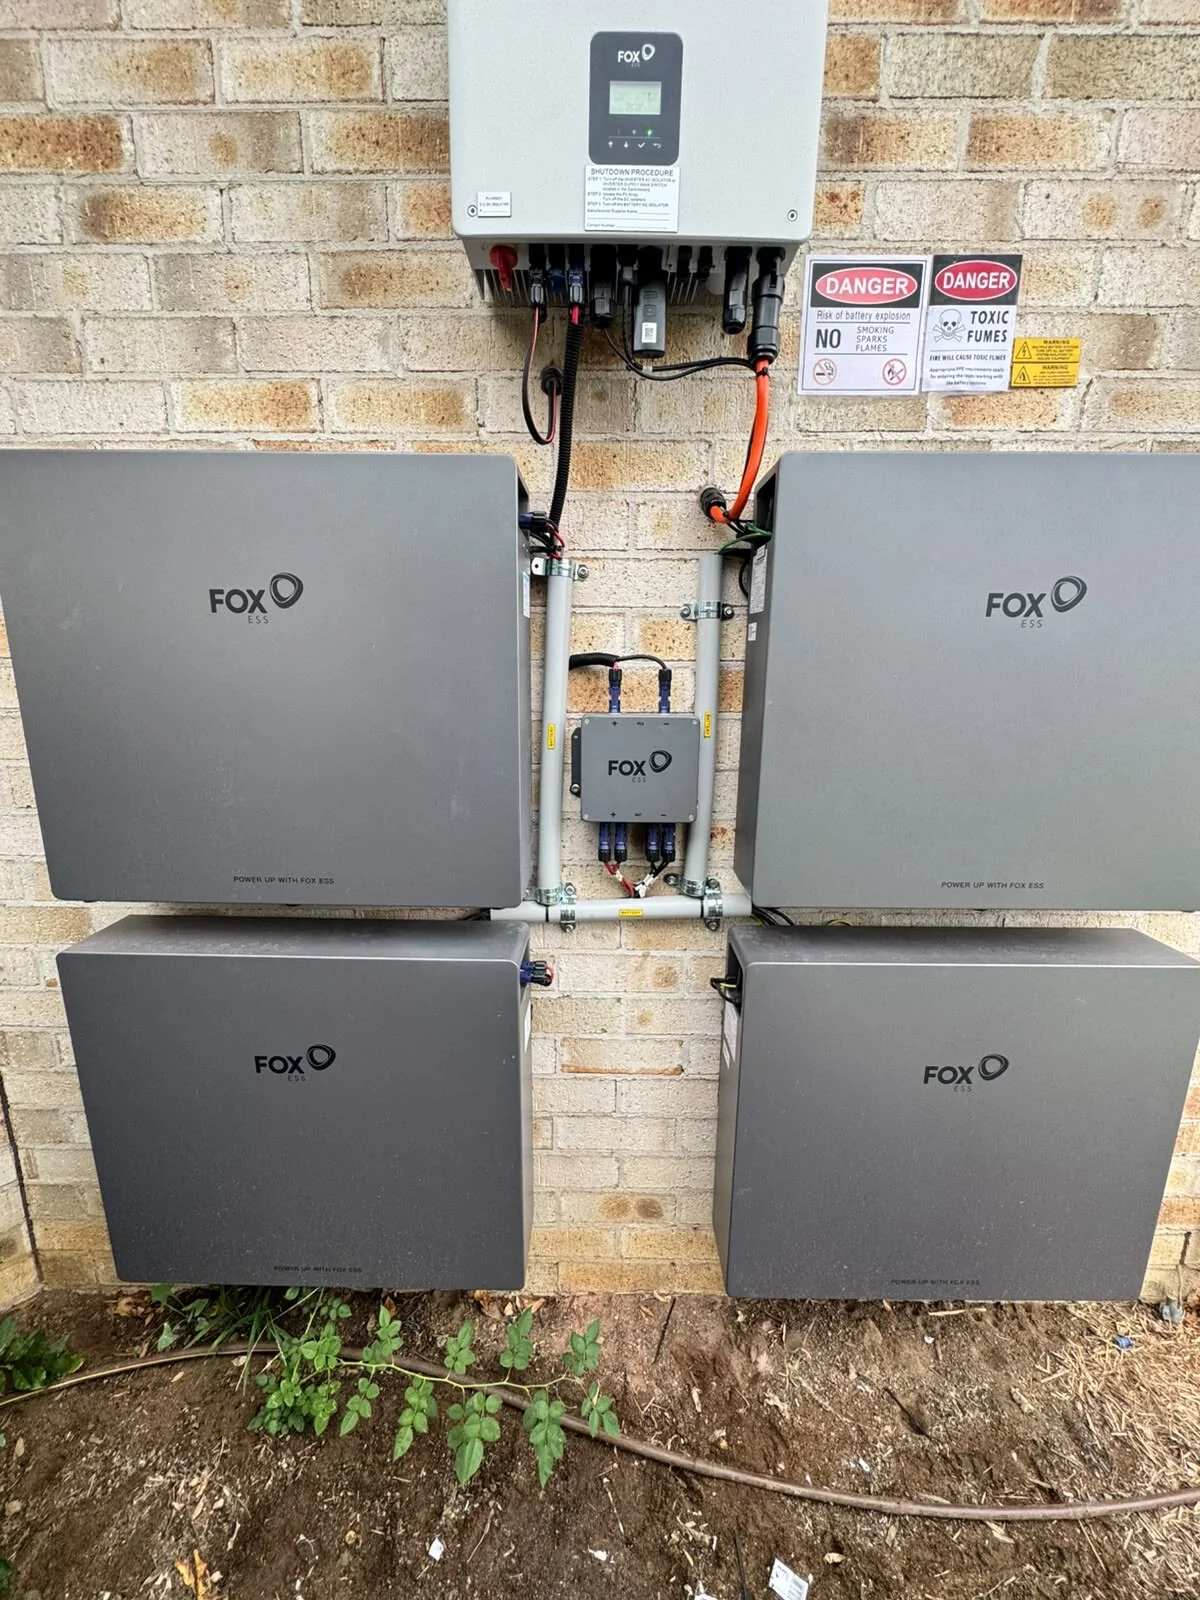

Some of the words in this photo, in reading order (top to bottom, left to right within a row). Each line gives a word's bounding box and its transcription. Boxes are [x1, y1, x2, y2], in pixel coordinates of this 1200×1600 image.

[618, 50, 640, 63] FOX
[825, 277, 909, 294] DANGER
[943, 272, 1010, 289] DANGER
[817, 310, 832, 320] Risk
[835, 311, 843, 320] of
[845, 311, 872, 322] battery
[876, 312, 910, 322] explosion
[970, 310, 1009, 324] TOXIC
[815, 329, 841, 348] NO
[967, 330, 1007, 342] FUMES
[209, 589, 268, 613] FOX
[985, 593, 1047, 618] FOX
[248, 615, 269, 624] ESS
[1020, 620, 1042, 628] ESS
[608, 760, 646, 776] FOX
[254, 1056, 305, 1074] FOX
[923, 1066, 974, 1084] FOX
